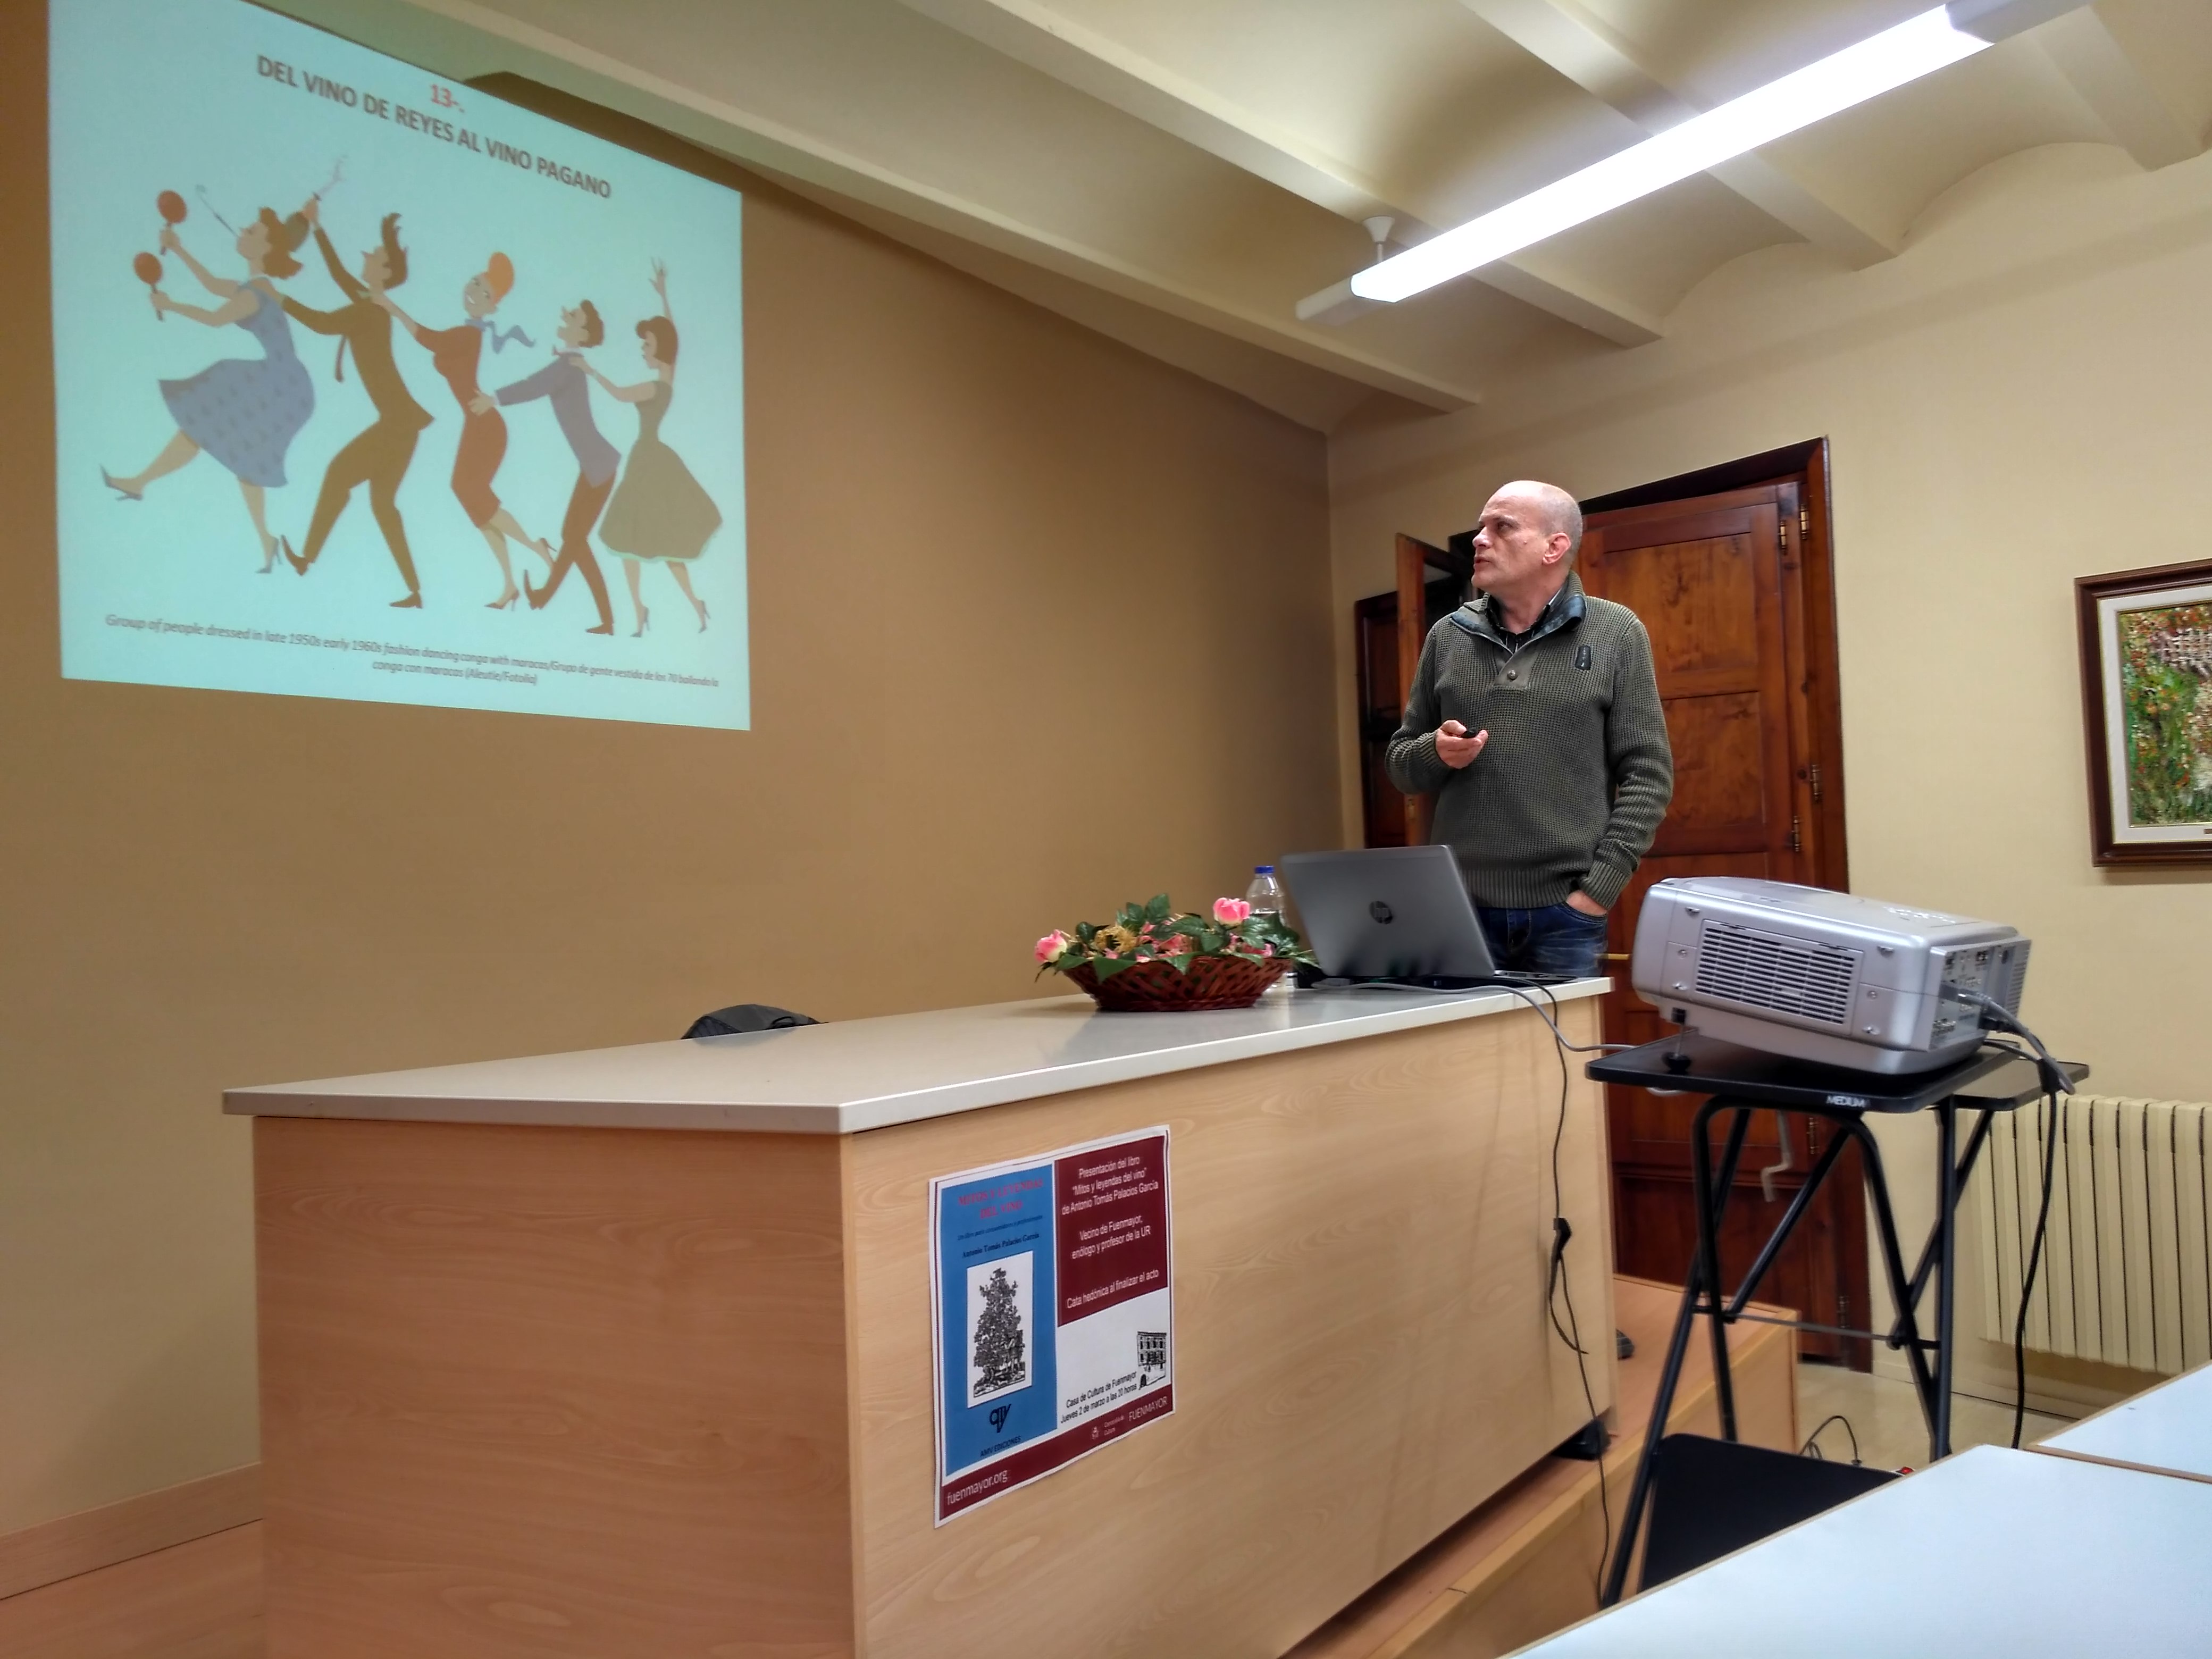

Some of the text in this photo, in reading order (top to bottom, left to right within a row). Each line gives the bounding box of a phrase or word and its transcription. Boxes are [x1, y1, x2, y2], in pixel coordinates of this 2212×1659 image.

[257, 55, 612, 199] DEL VINO DE REYES AL VINO PAGANO
[106, 614, 146, 631] Group
[147, 618, 163, 633] of
[163, 622, 204, 636] people
[206, 624, 250, 640] dressed
[252, 629, 263, 641] in
[265, 630, 287, 643] late
[289, 633, 322, 647] 1950s
[323, 638, 349, 652] early
[351, 640, 382, 653] 1960s
[382, 642, 421, 656] fashion
[421, 647, 459, 663] dancing
[460, 653, 489, 665] conga
[489, 655, 509, 665] with
[577, 664, 589, 674] de
[589, 666, 613, 677] gente
[643, 671, 654, 681] de
[655, 671, 666, 682] los
[667, 673, 677, 683] 70
[678, 673, 711, 686] bailando
[372, 661, 404, 674] conga
[404, 664, 423, 674] con
[423, 666, 464, 678] maracas
[1078, 1155, 1140, 1179] Presentación del libro
[958, 1177, 1043, 1205] MITOS Y LEYENDAS
[1091, 1182, 1095, 1194] y
[1096, 1176, 1122, 1191] leyendas
[1122, 1171, 1133, 1183] del
[979, 1200, 1023, 1219] DEL VINO
[1062, 1179, 1159, 1216] de Antonio Tomás Palacios García
[1071, 1225, 1152, 1260] enólogo y profesor de la UR
[1079, 1228, 1100, 1241] Vecino
[1100, 1224, 1108, 1235] de
[962, 1247, 983, 1259] Antonio
[984, 1242, 1001, 1253] Tomás
[1002, 1237, 1022, 1247] Palacios
[1066, 1268, 1160, 1309] Cata hedónica al finalizar el acto
[1066, 1371, 1137, 1408] Casa de Cultura de Fuenmayor
[1078, 1405, 1083, 1415] 2
[1083, 1403, 1090, 1413] de
[1090, 1397, 1105, 1409] marzo
[1105, 1395, 1110, 1404] a
[1117, 1388, 1124, 1398] 20
[1124, 1382, 1137, 1395] horas
[1128, 1395, 1168, 1422] FUENMAYOR
[994, 1435, 1021, 1453] EDICIONES
[946, 1469, 1008, 1506] fuenmayor.org
